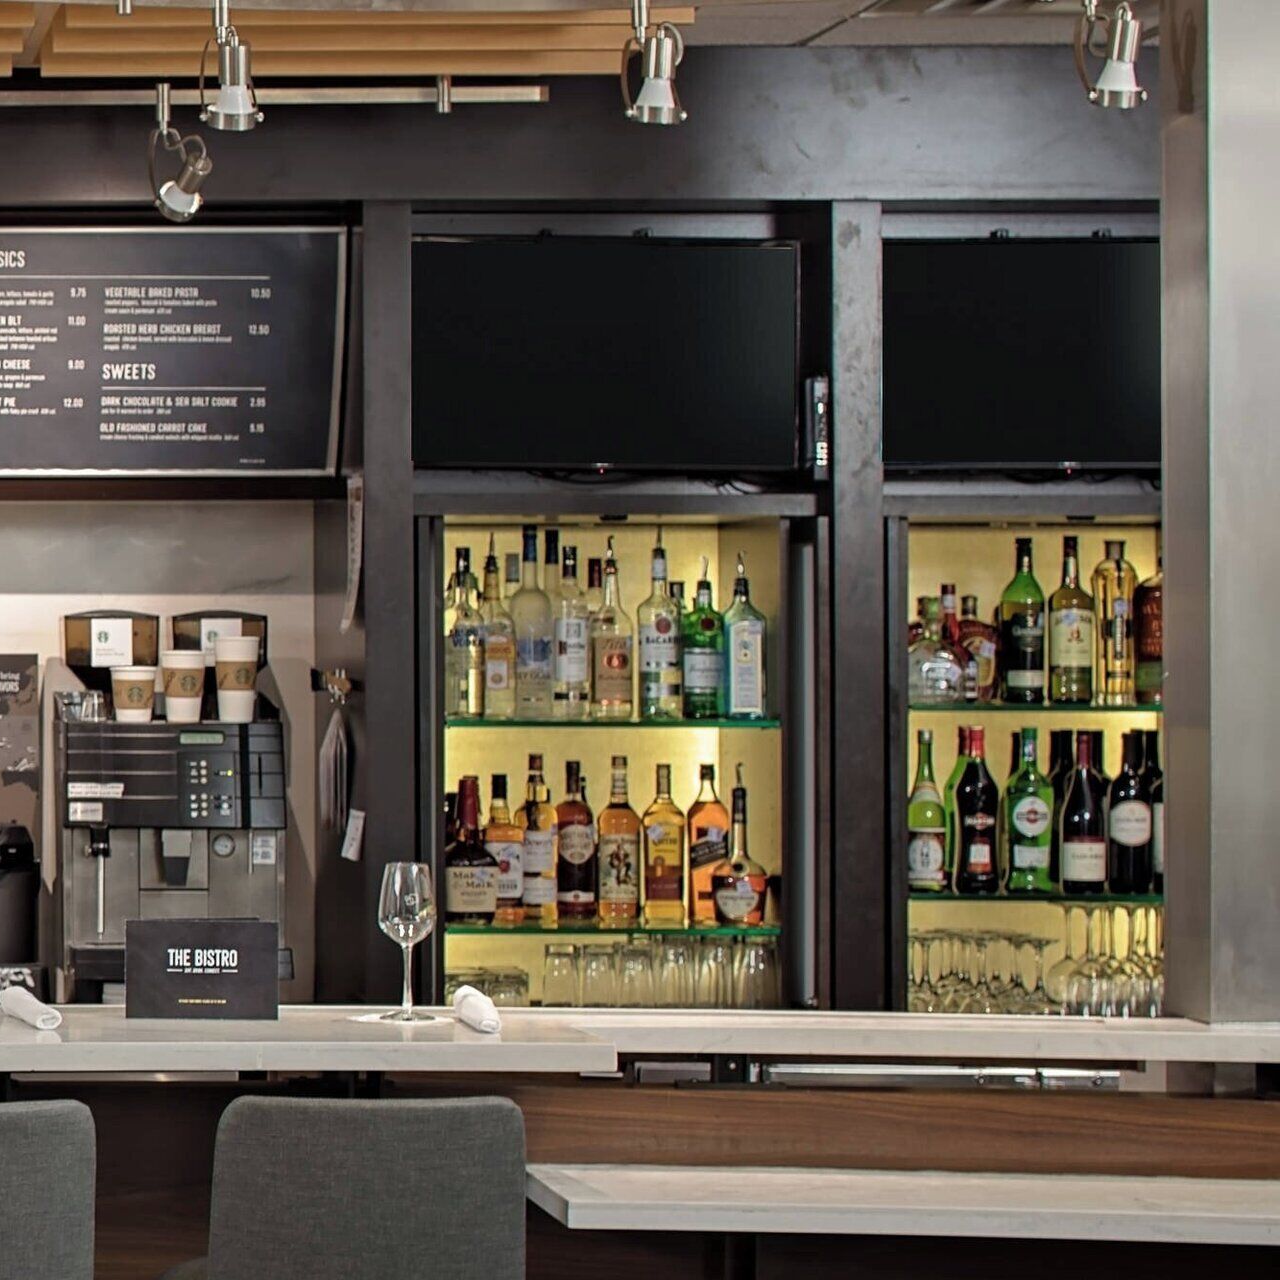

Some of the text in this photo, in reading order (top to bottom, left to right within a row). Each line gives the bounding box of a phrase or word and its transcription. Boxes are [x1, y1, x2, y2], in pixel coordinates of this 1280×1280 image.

[104, 287, 146, 298] VEGETABLE
[148, 287, 173, 298] BAKED
[174, 287, 199, 298] PASTA
[8, 315, 21, 326] BLT
[104, 324, 221, 335] ROASTED HERB CHICKEN BREAST
[3, 359, 31, 369] CHEESE
[102, 363, 156, 380] SWEETS
[3, 397, 16, 406] PIE
[101, 397, 238, 407] DARK CHOCOLATE & SEA SALT COOKIE
[100, 423, 207, 433] OLD FASHIONED CARROT CAKE
[167, 949, 238, 966] THE BISTRO
